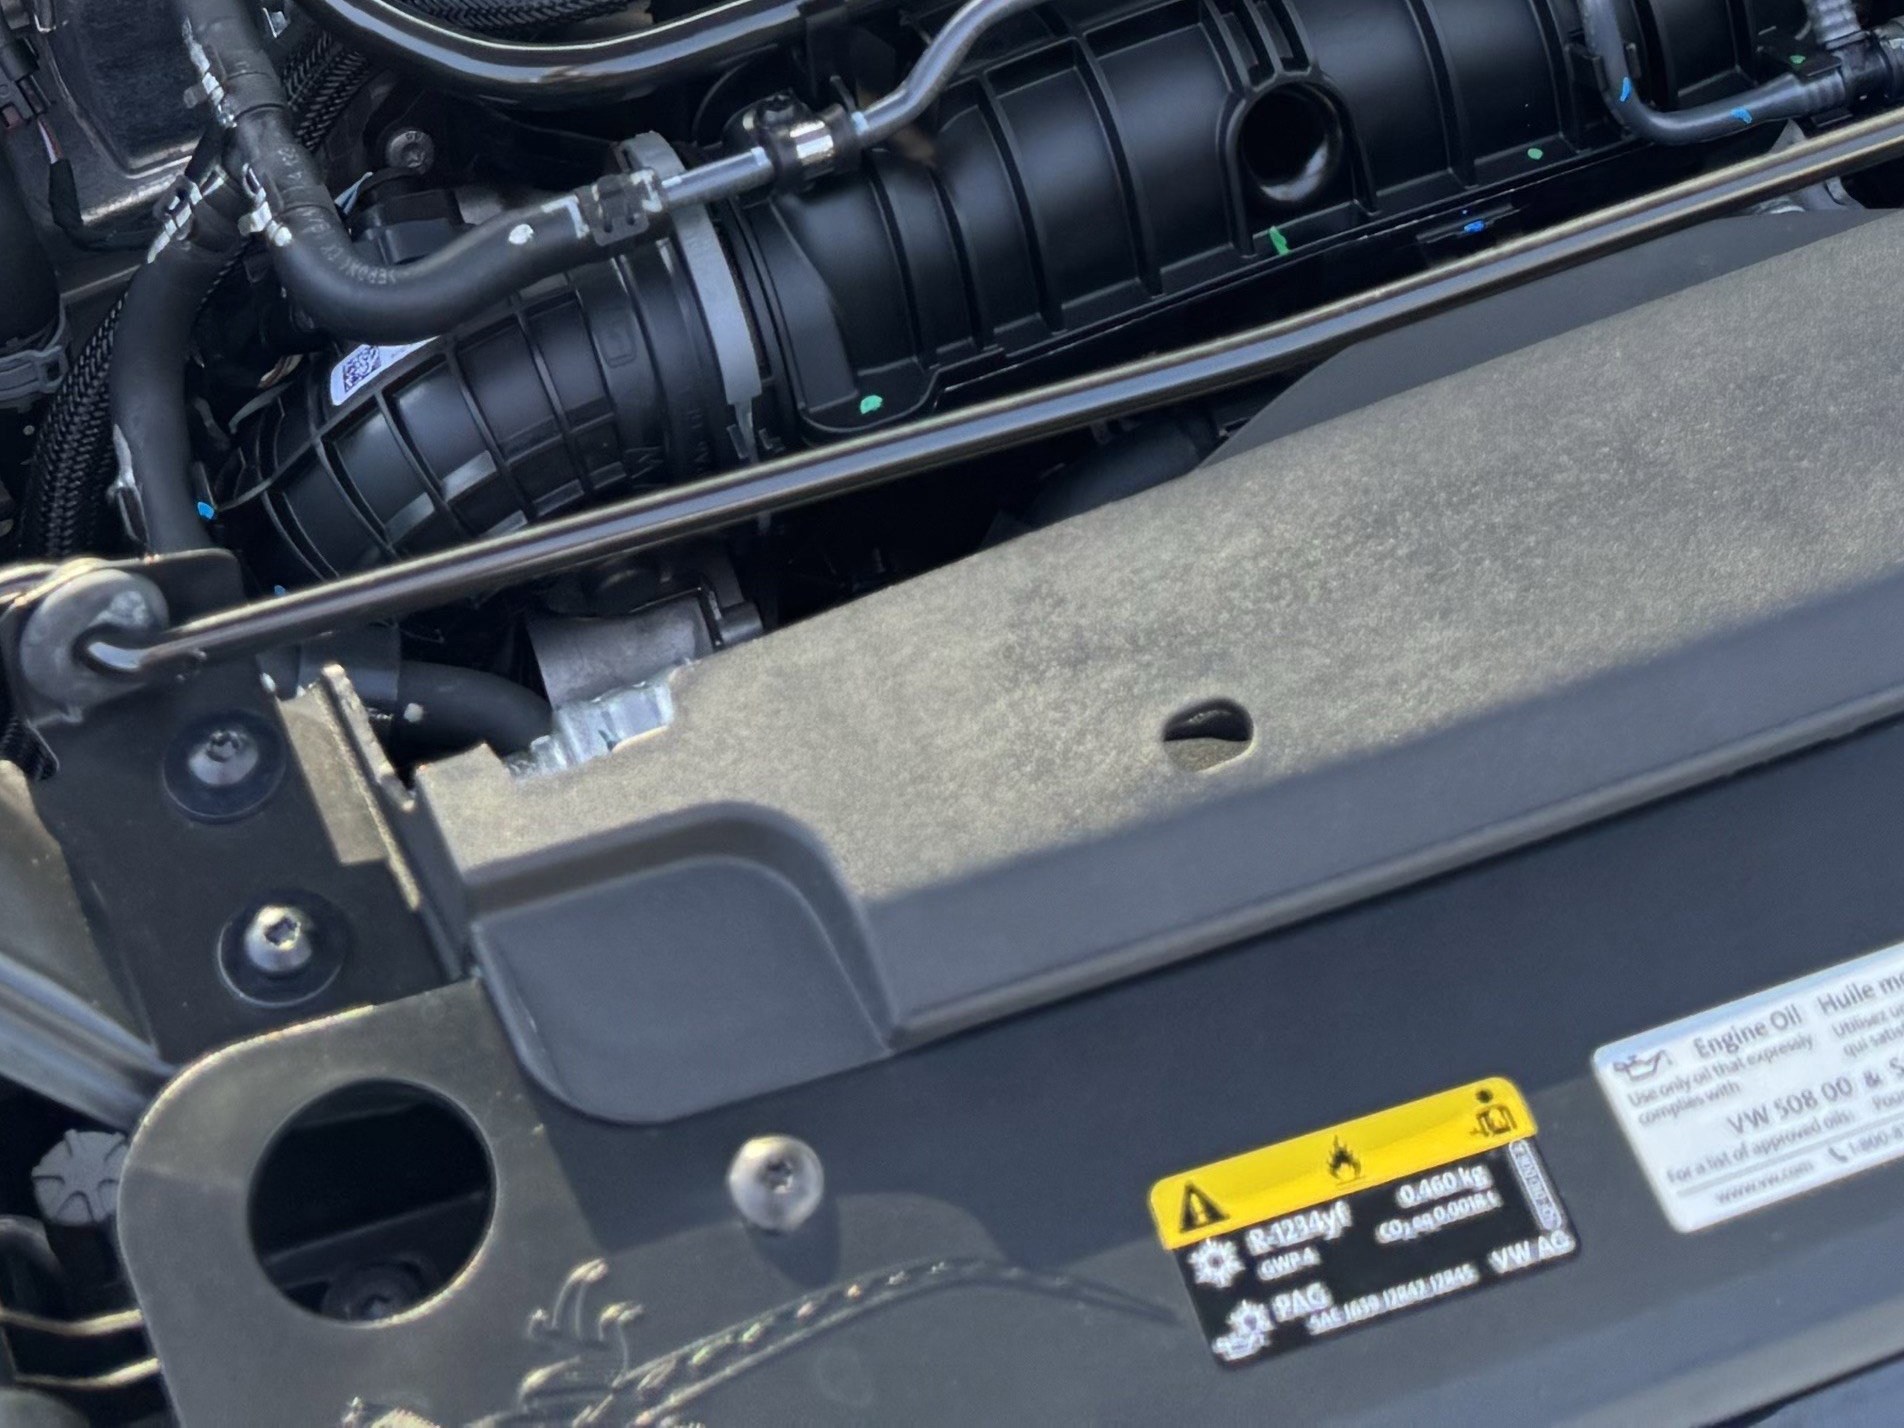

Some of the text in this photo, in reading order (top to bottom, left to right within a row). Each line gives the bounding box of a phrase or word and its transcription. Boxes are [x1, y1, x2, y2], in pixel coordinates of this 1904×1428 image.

[1691, 1016, 1771, 1062] Engine
[1764, 1003, 1805, 1033] Oil
[1815, 978, 1879, 1016] Huile
[1626, 1085, 1660, 1109] Use
[1724, 1104, 1774, 1138] VW
[1770, 1086, 1822, 1121] 508
[1817, 1074, 1857, 1104] 00
[1860, 1067, 1884, 1089] &
[1243, 1198, 1357, 1263] R-1234yf
[1393, 1169, 1460, 1211] 0.460
[1456, 1158, 1494, 1194] kg
[1487, 1239, 1535, 1275] VW
[1531, 1225, 1577, 1262] AG
[1269, 1279, 1333, 1322] PAG
